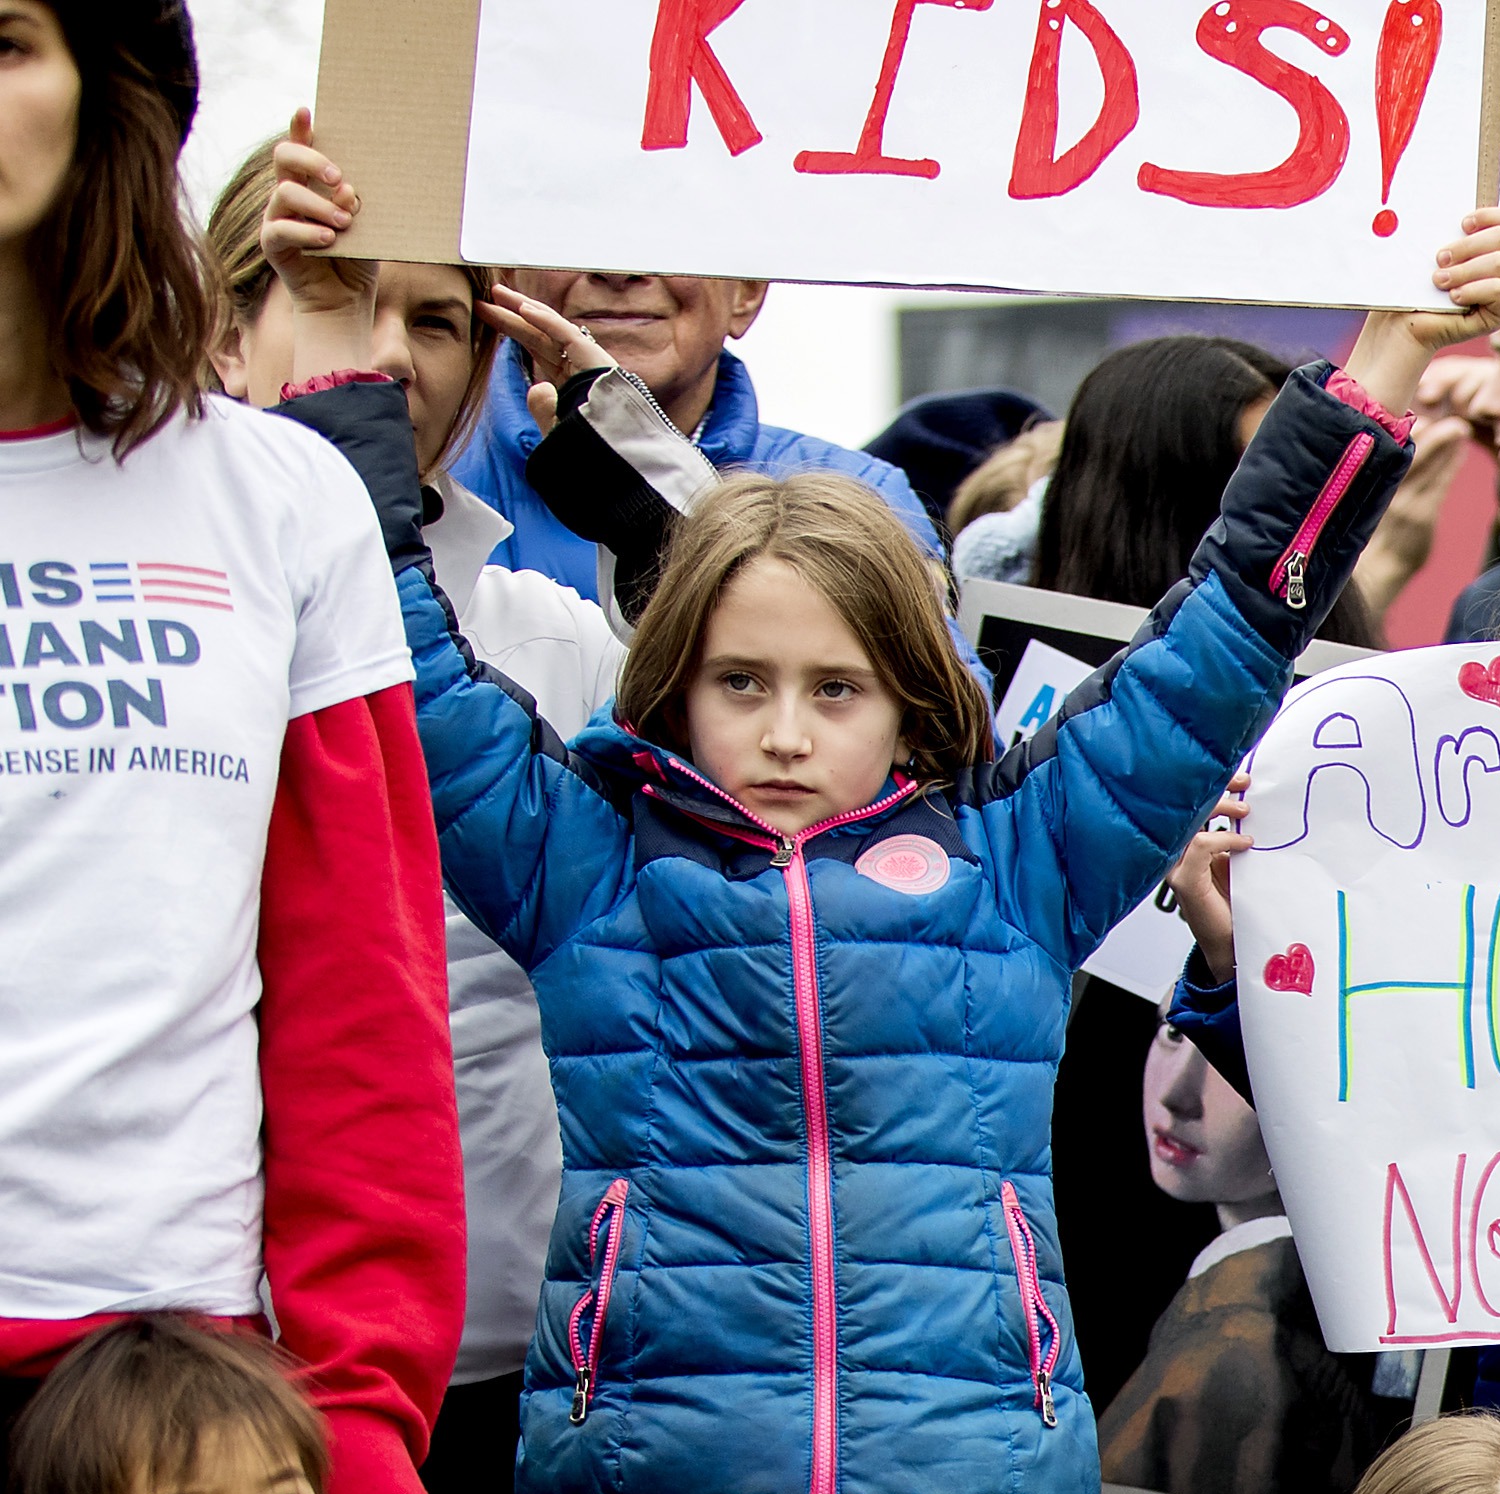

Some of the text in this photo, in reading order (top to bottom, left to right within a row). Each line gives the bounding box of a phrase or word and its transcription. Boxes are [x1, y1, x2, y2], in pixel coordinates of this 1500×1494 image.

[640, 0, 1441, 238] KIDS!
[0, 618, 201, 669] AND
[0, 678, 168, 733] ION
[89, 747, 115, 774] IN
[128, 745, 250, 784] AMERICA
